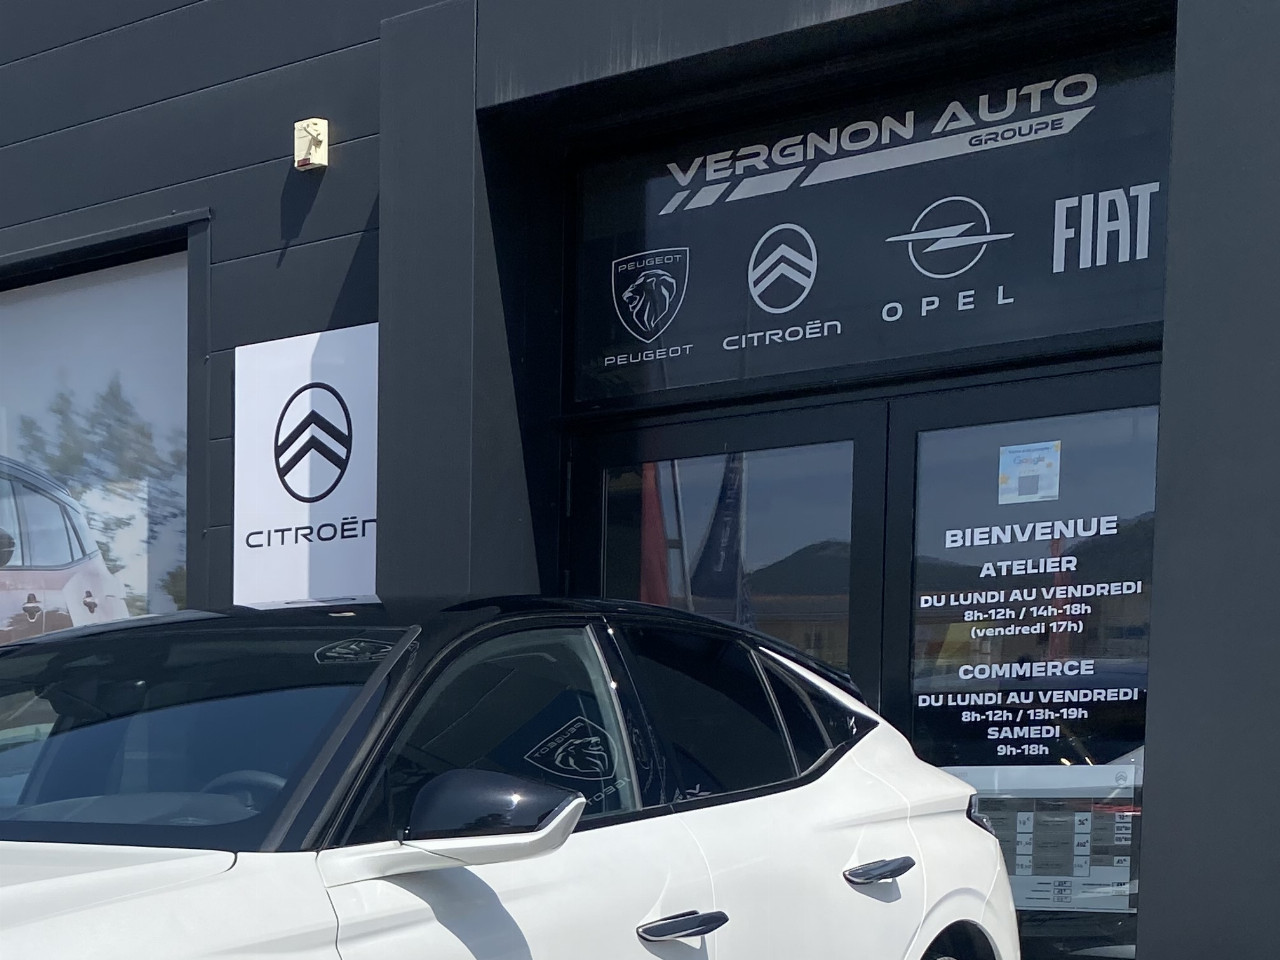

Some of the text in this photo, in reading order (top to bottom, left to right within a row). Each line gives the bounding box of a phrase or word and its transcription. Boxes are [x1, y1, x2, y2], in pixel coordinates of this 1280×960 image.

[666, 73, 1098, 187] VERGNON AUTO
[968, 117, 1065, 148] GROUPE
[1052, 181, 1160, 274] FIAT
[618, 254, 682, 273] PEUGEOT
[881, 285, 1015, 322] OPEL
[604, 343, 694, 367] PEUGEOT
[945, 515, 1118, 548] BIENVENUE
[979, 555, 1078, 578] ATELIER
[920, 580, 1143, 608] DU LUNDI AU VENDREDI
[963, 607, 1016, 622] 8h-12h
[1029, 603, 1091, 618] 14h-18h
[970, 620, 1084, 639] (vendredi 17h)
[958, 659, 1095, 680] COMMERCE
[917, 687, 1139, 707] DU LUNDI AU VENDREDI
[961, 709, 1013, 722] 8h-12h
[1026, 707, 1089, 721] 13h-19h
[987, 725, 1060, 739] SAMEDI
[997, 743, 1049, 756] 9h-18h
